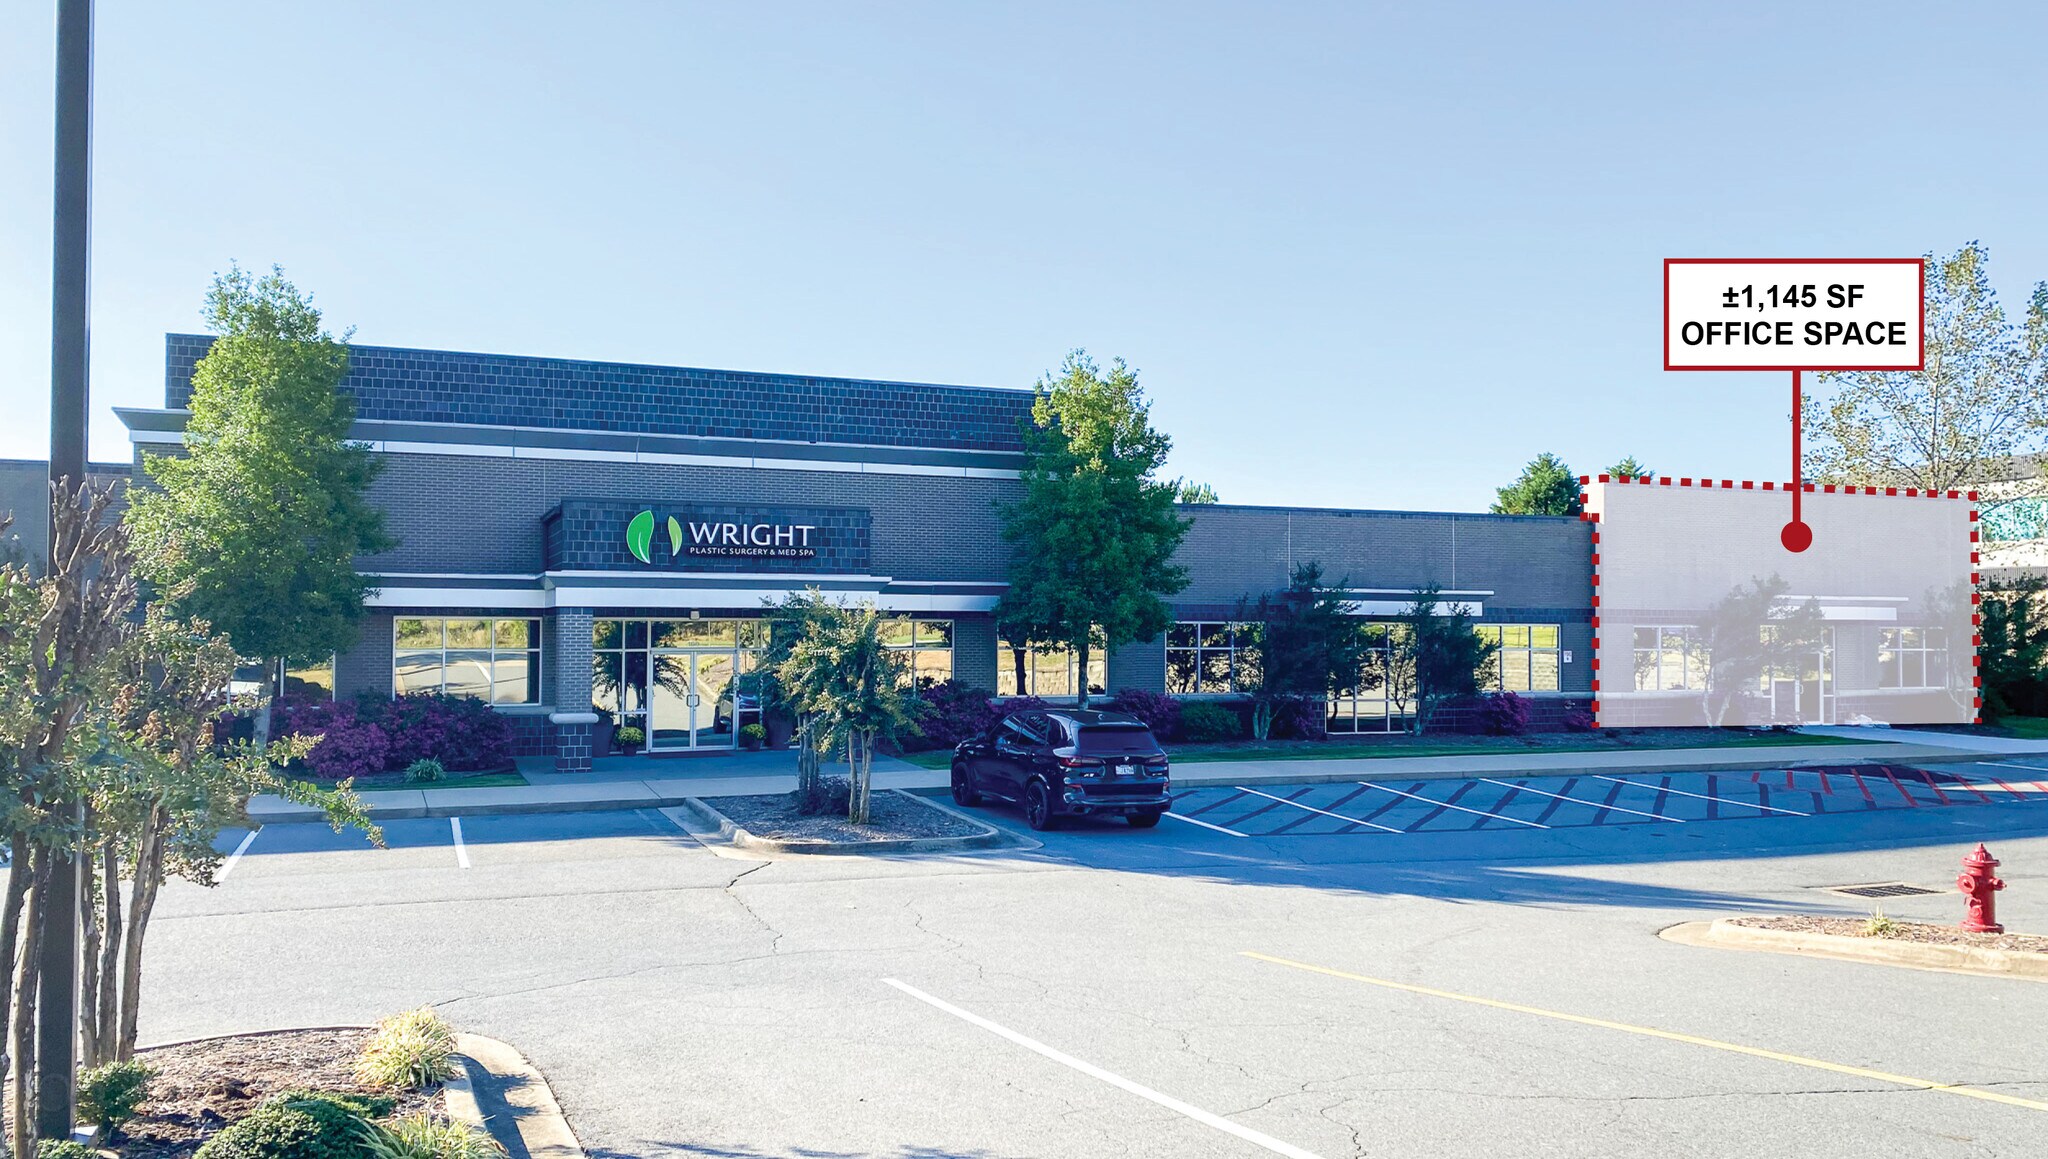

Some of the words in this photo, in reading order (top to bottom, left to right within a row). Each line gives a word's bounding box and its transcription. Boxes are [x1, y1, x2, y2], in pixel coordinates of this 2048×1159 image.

[689, 522, 815, 546] WRIGHT
[690, 547, 727, 555] PLASTIC
[729, 547, 768, 556] SURGERY
[799, 549, 815, 557] SPA
